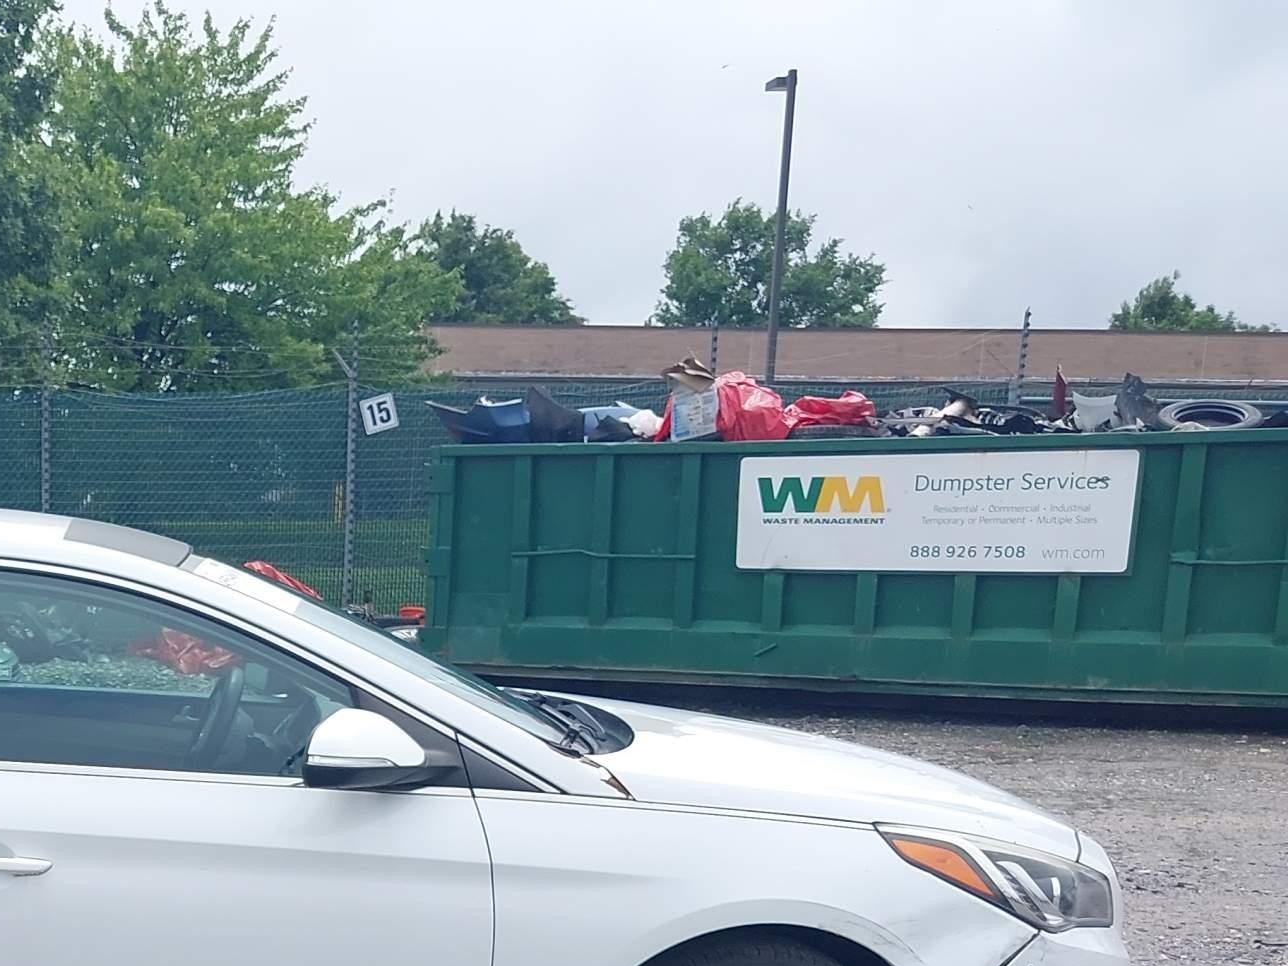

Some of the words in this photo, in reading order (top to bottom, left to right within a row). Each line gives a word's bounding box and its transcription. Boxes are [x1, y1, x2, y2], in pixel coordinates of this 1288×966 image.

[367, 401, 391, 426] 15
[915, 474, 1015, 496] Dumpster
[1021, 472, 1110, 490] Services
[757, 476, 885, 513] WM
[933, 504, 978, 513] Residential
[988, 504, 1040, 513] Commercial
[1050, 504, 1091, 512] Industrial
[762, 517, 801, 525] WASTE
[803, 517, 885, 525] MANAGEMENT
[922, 516, 965, 526] Temporary
[979, 516, 1026, 525] Permanent
[1038, 516, 1072, 526] Multiple
[1075, 515, 1098, 524] Sizes
[910, 545, 940, 558] 888
[946, 545, 977, 558] 926
[984, 545, 1026, 558] 7508
[1041, 548, 1105, 559] wm.com
